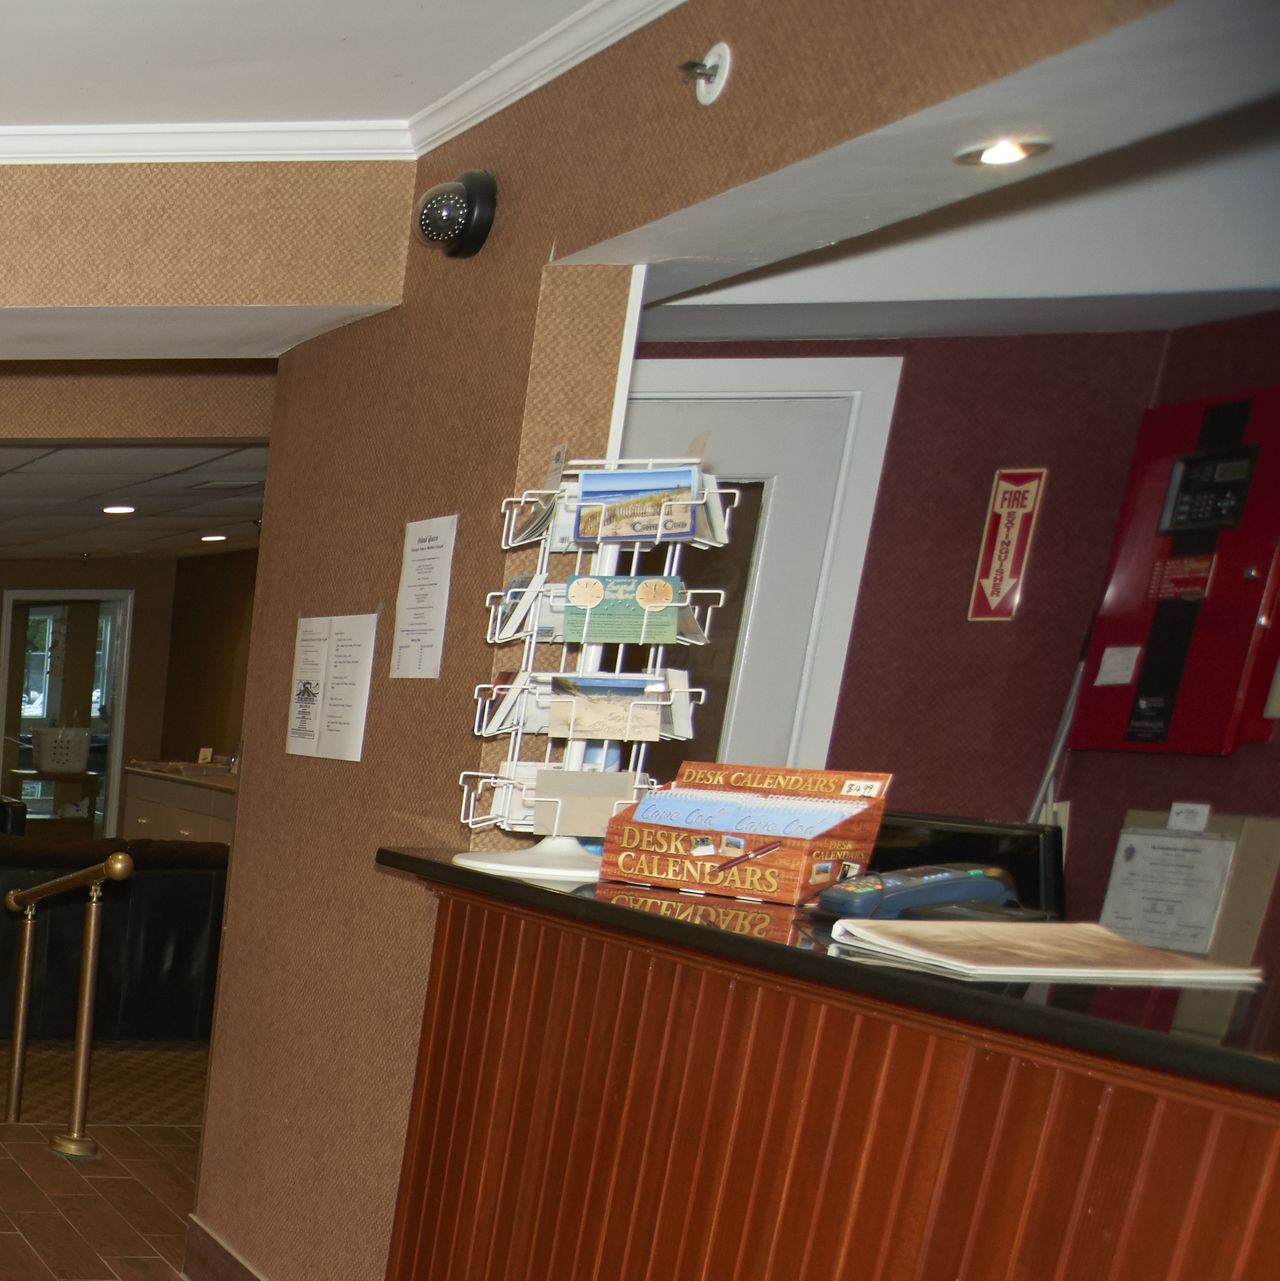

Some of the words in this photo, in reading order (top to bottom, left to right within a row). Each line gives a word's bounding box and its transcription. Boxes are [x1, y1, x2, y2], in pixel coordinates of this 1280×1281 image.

[1000, 490, 1029, 509] FIRE
[990, 511, 1017, 598] EXTINGUISHER
[682, 768, 725, 785] DESK
[729, 771, 839, 794] CALENDARS
[621, 826, 692, 857] DESK
[617, 852, 782, 894] CALENDARS
